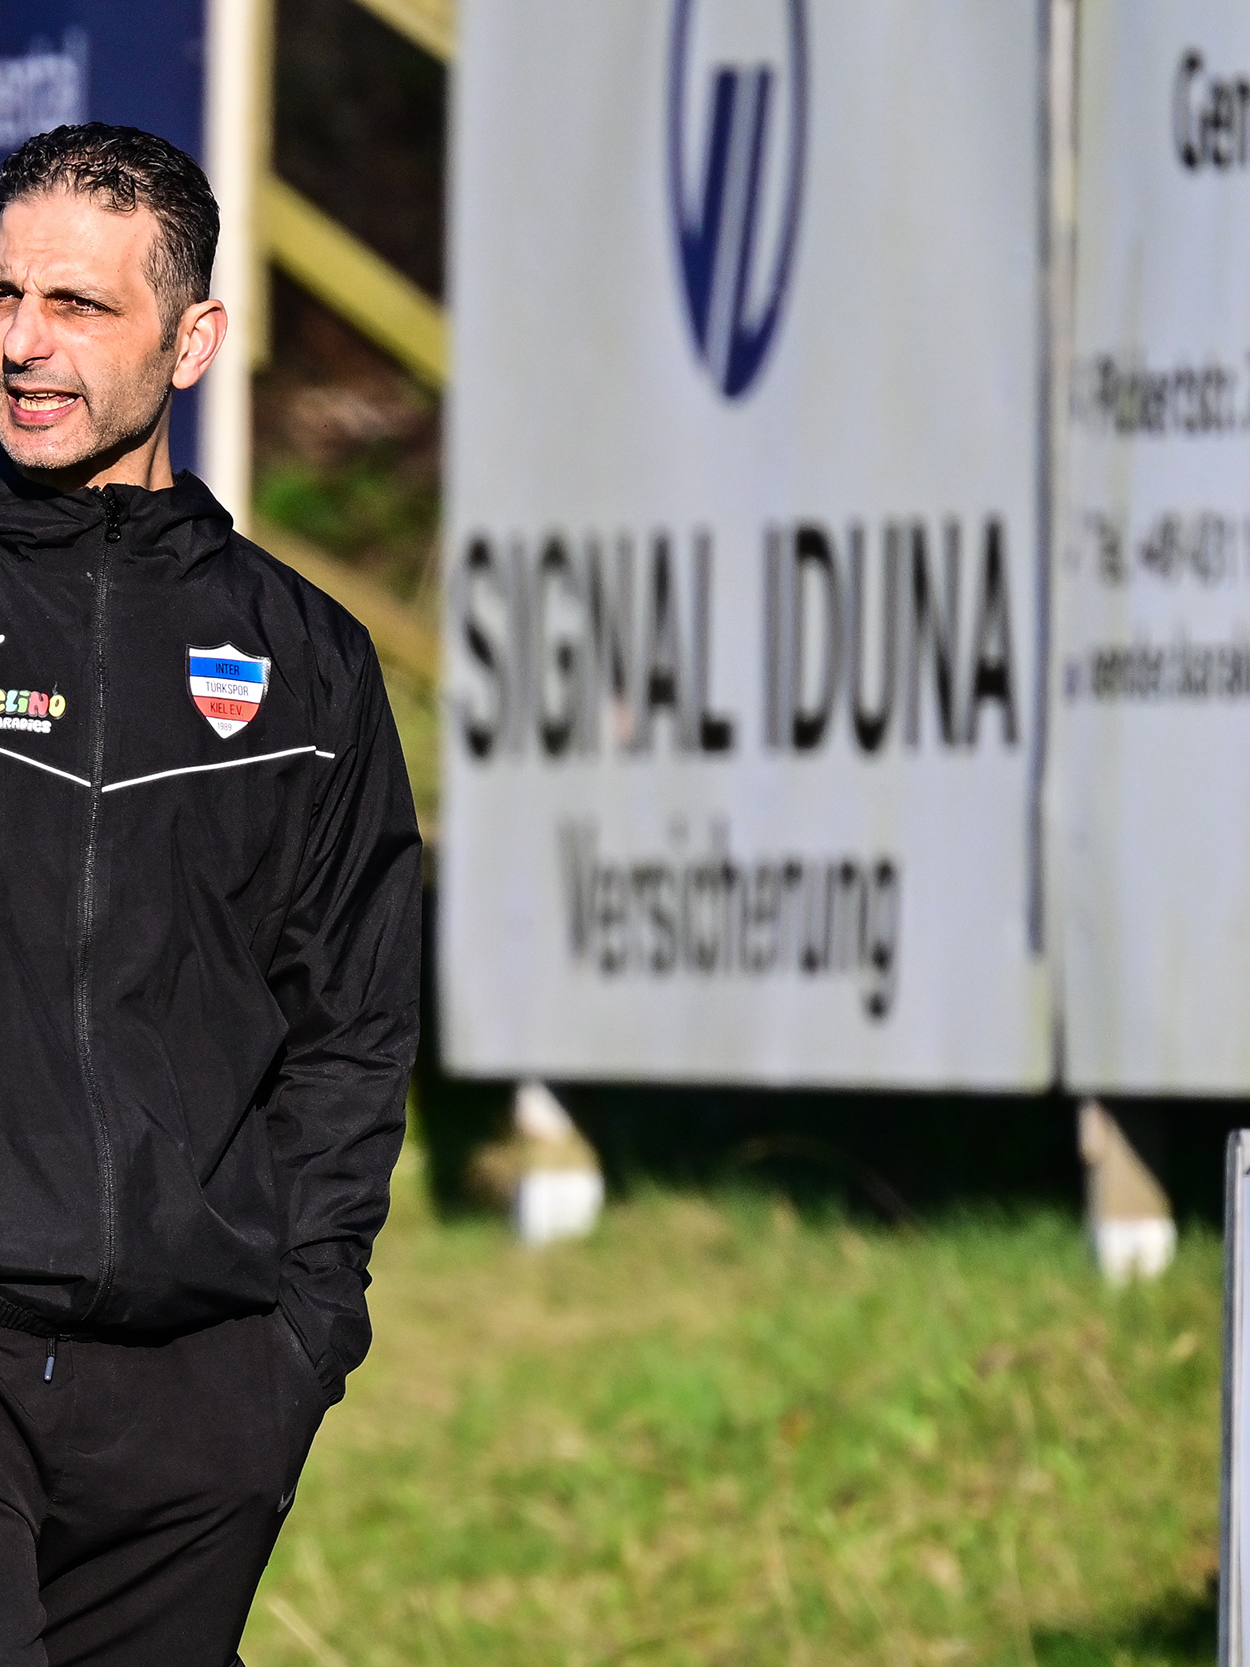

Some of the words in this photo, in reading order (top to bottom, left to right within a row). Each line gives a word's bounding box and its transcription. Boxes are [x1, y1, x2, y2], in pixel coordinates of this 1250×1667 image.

[215, 663, 240, 676] INTER
[457, 528, 736, 762] SIGNAL
[763, 513, 1020, 757] IDUNA
[210, 701, 228, 715] KIEL
[229, 704, 244, 717] E.V.
[559, 816, 901, 1019] Versicherung
